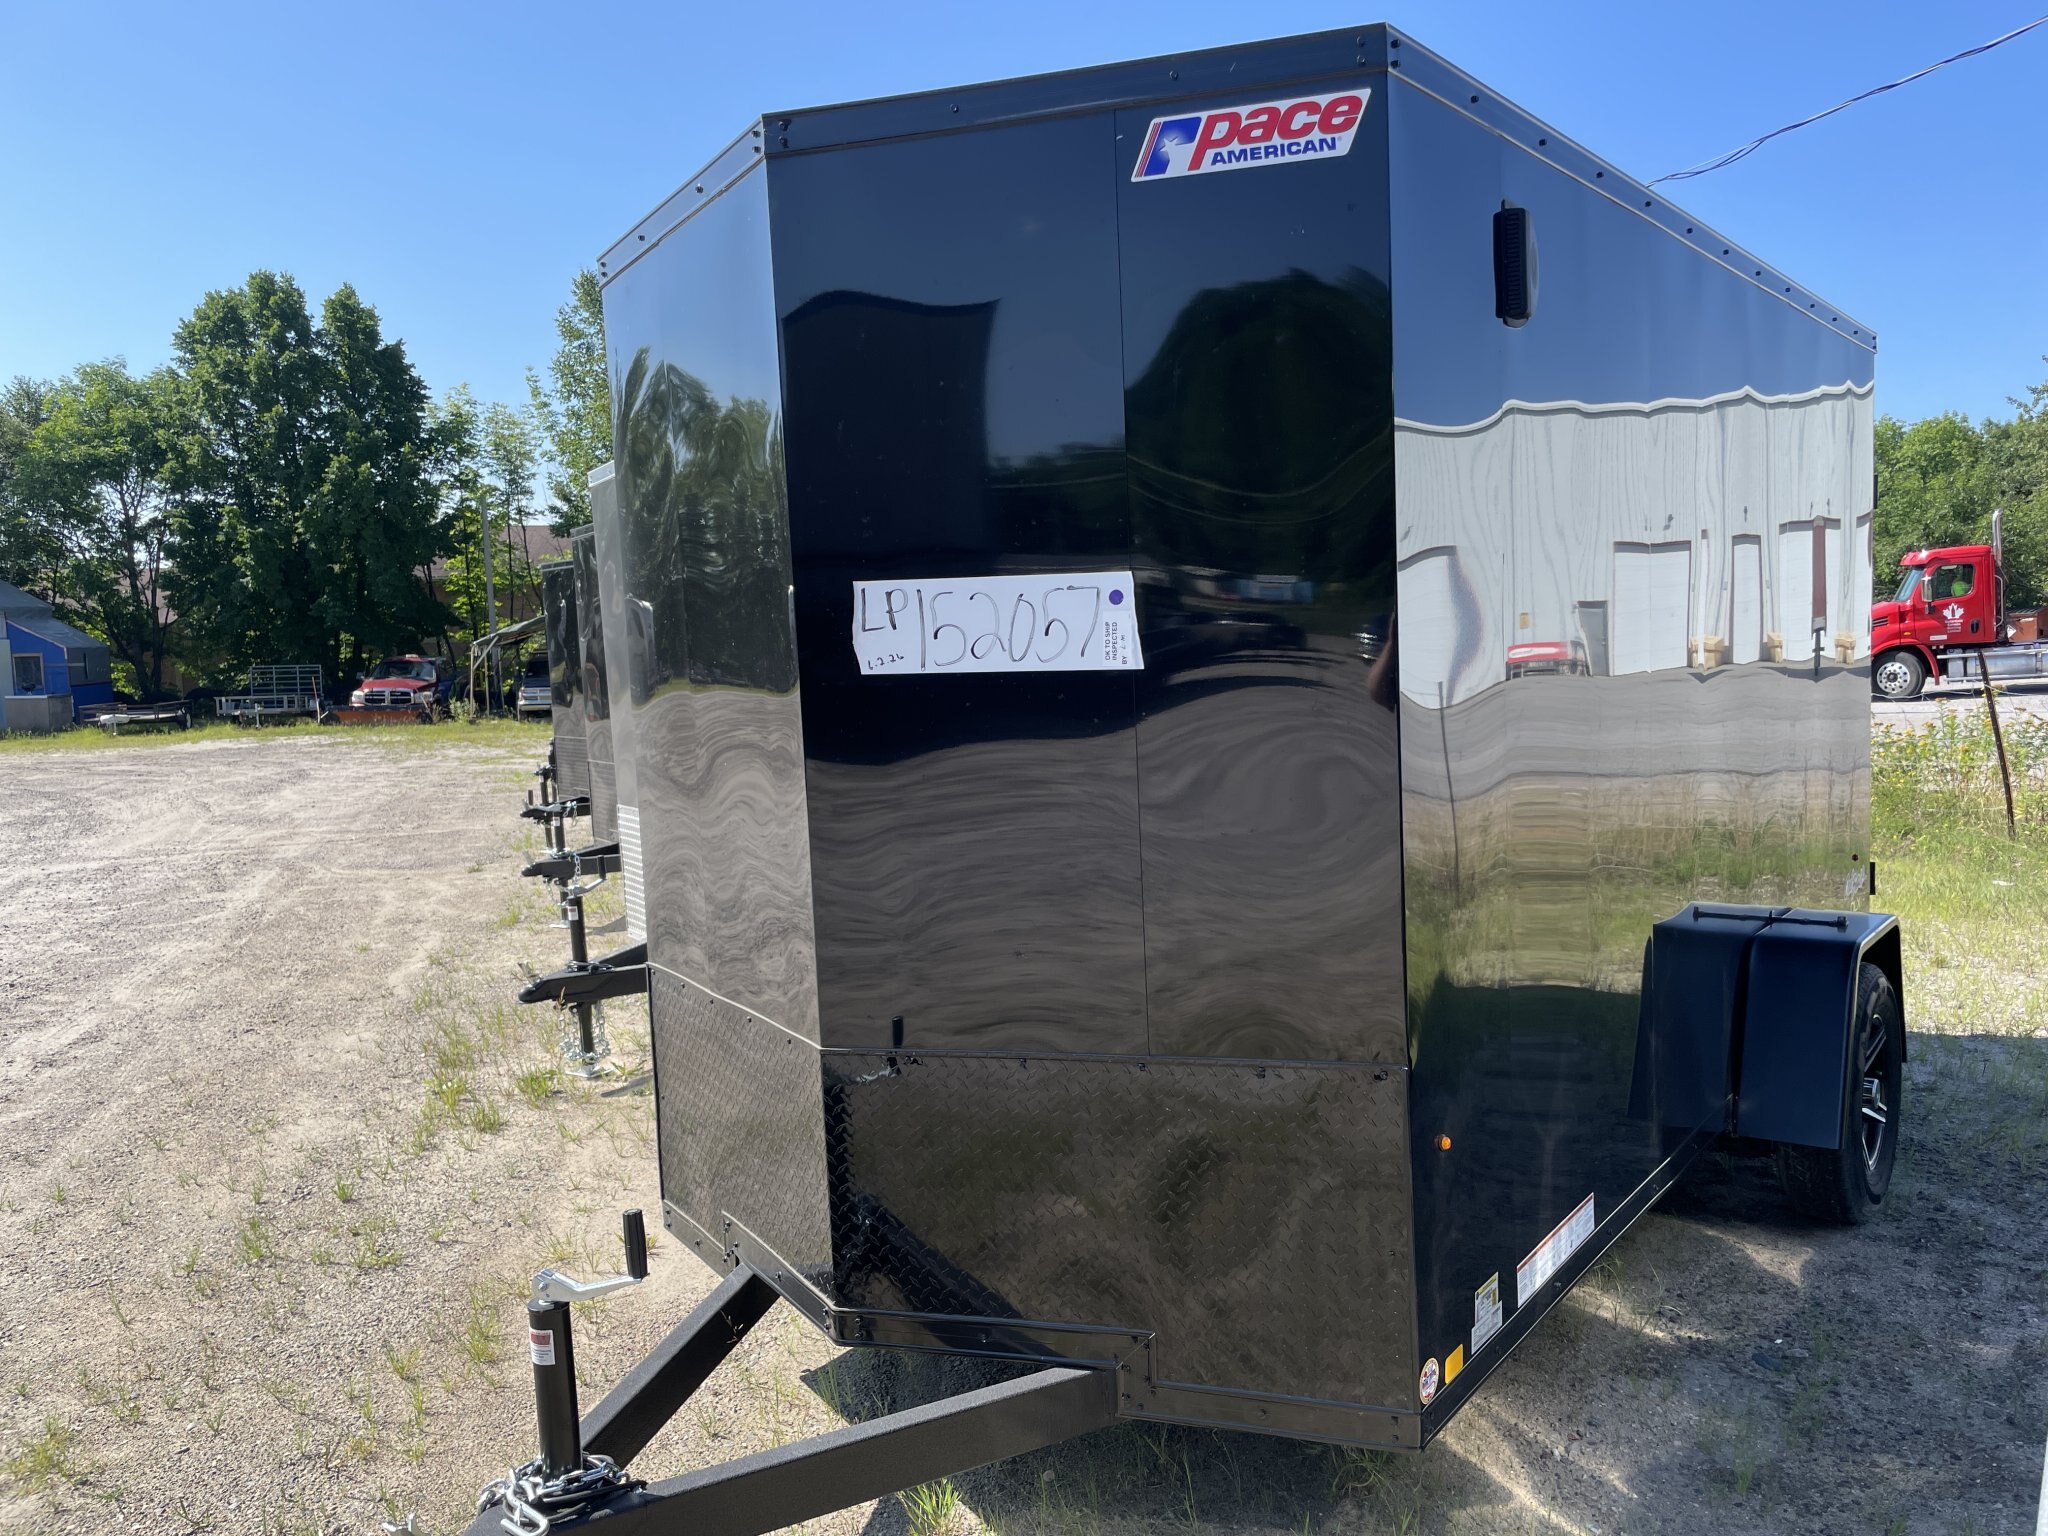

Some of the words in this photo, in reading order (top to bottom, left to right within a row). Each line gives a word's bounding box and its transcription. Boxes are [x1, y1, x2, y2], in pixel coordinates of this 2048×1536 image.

[1187, 95, 1363, 171] pace
[1210, 137, 1337, 166] AMERICAN
[1104, 639, 1111, 649] TO
[1104, 650, 1111, 661] OK
[1121, 655, 1128, 665] BY
